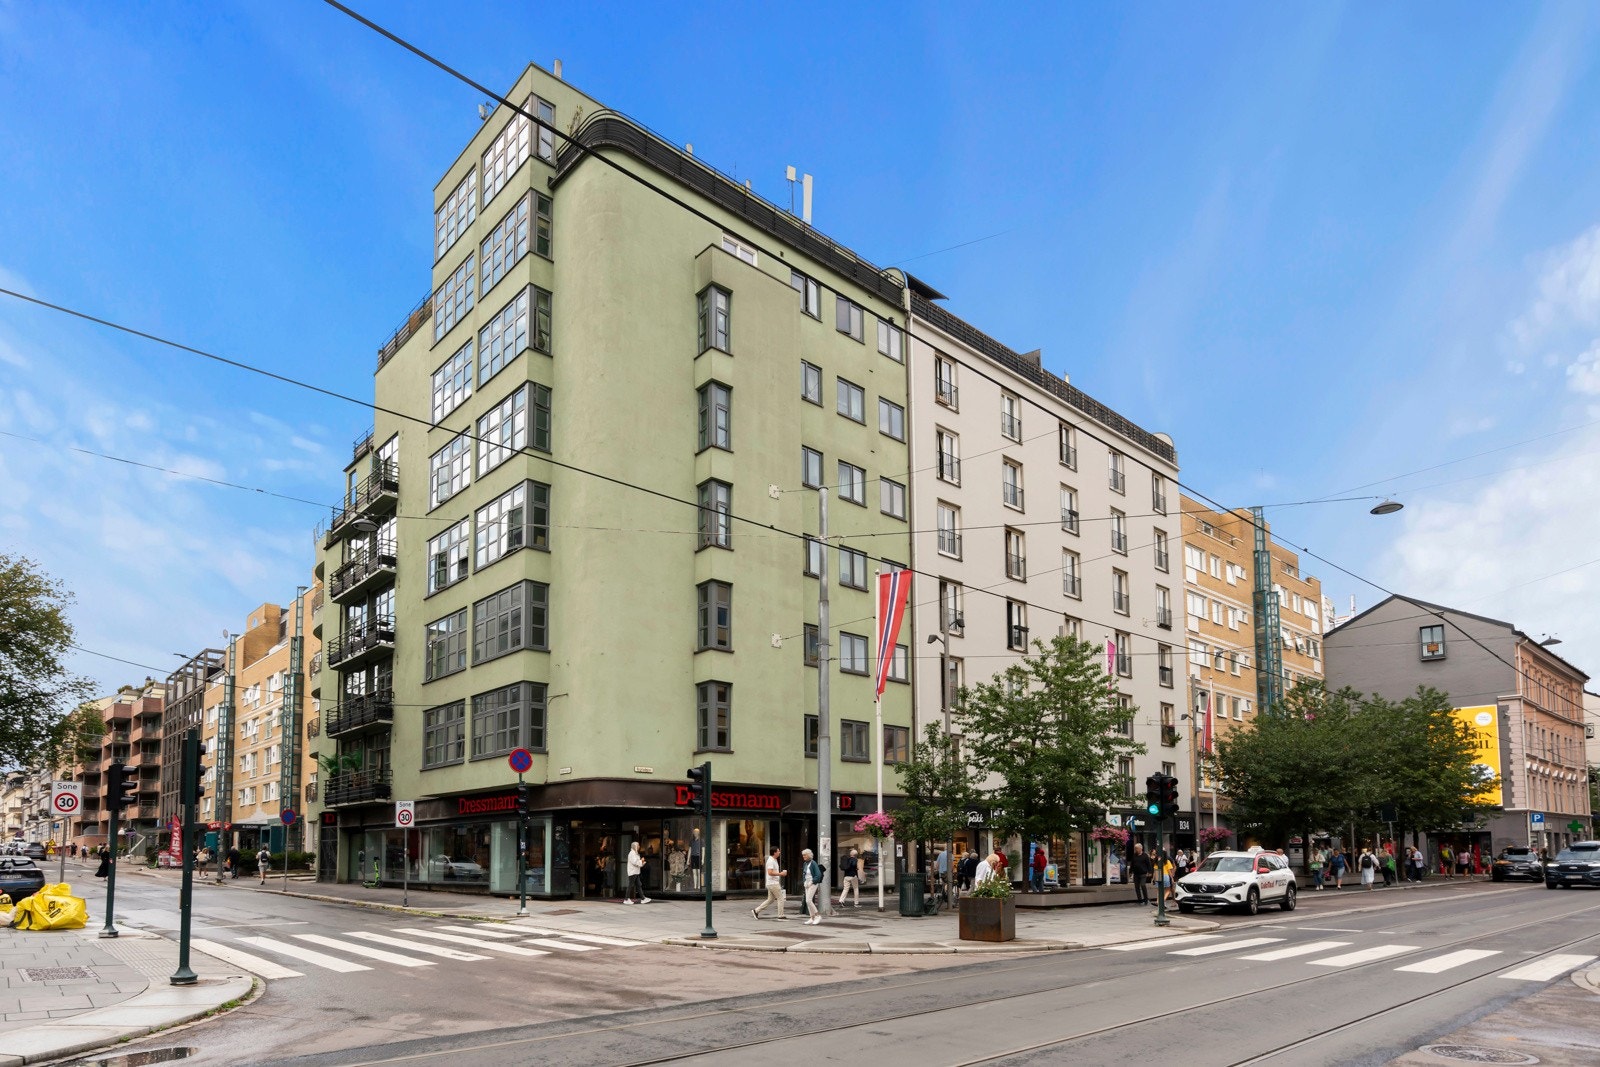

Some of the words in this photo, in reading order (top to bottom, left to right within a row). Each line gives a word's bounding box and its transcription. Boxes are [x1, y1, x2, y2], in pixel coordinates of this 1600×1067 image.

[59, 797, 74, 807] 30
[675, 785, 780, 809] Dssmann
[458, 795, 521, 814] Dressmann
[400, 813, 410, 821] 30
